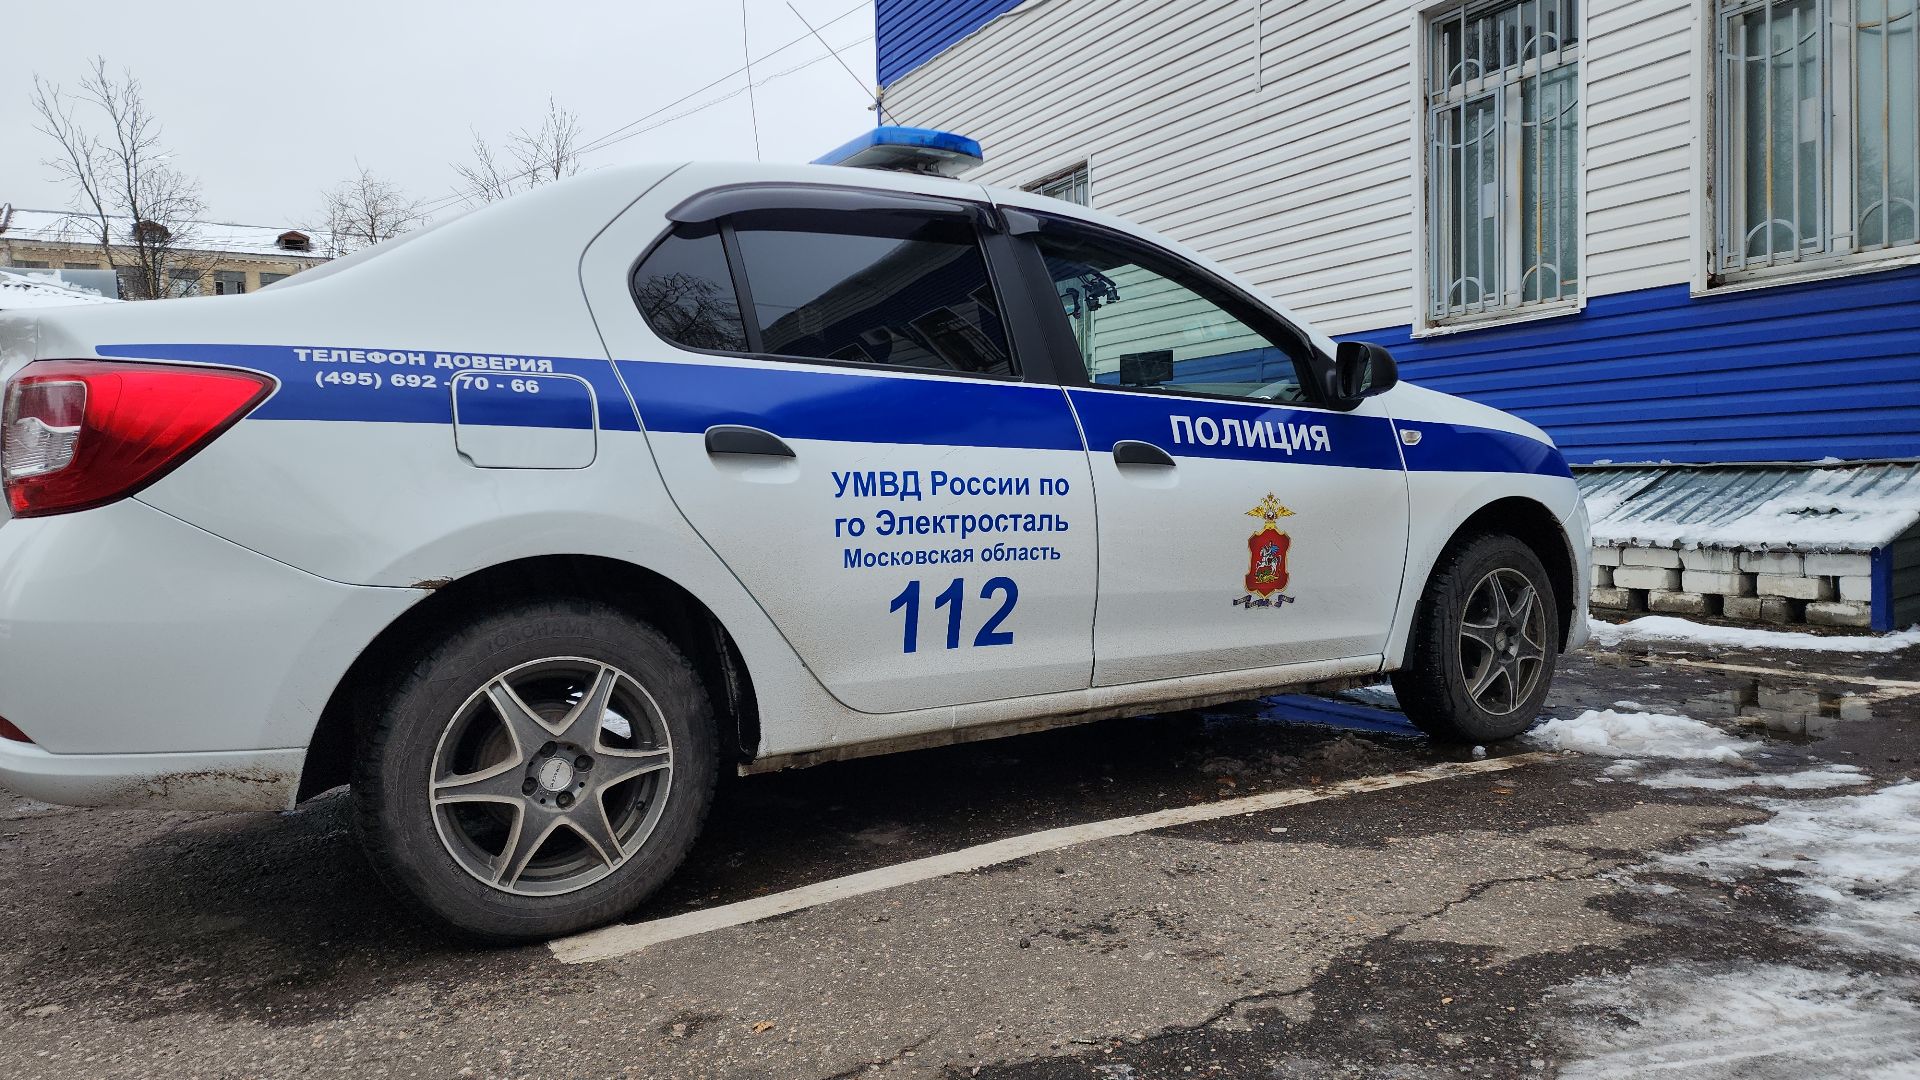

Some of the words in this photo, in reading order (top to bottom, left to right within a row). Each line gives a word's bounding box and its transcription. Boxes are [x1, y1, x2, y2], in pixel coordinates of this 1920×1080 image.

[293, 349, 426, 366] ТЕЛЕФОН
[433, 353, 553, 373] ДОВЕРИЯ
[315, 371, 382, 389] (495)
[390, 374, 437, 388] 692
[462, 376, 489, 392] 70
[511, 379, 540, 394] 66
[1169, 415, 1332, 455] ПОЛИЦИЯ
[831, 470, 922, 501] УМВД
[931, 470, 1030, 496] России
[1039, 477, 1070, 496] по
[835, 517, 866, 537] го
[875, 509, 1069, 539] Электросталь
[843, 548, 974, 568] Московская
[981, 542, 1061, 562] область
[890, 576, 1019, 653] 112
